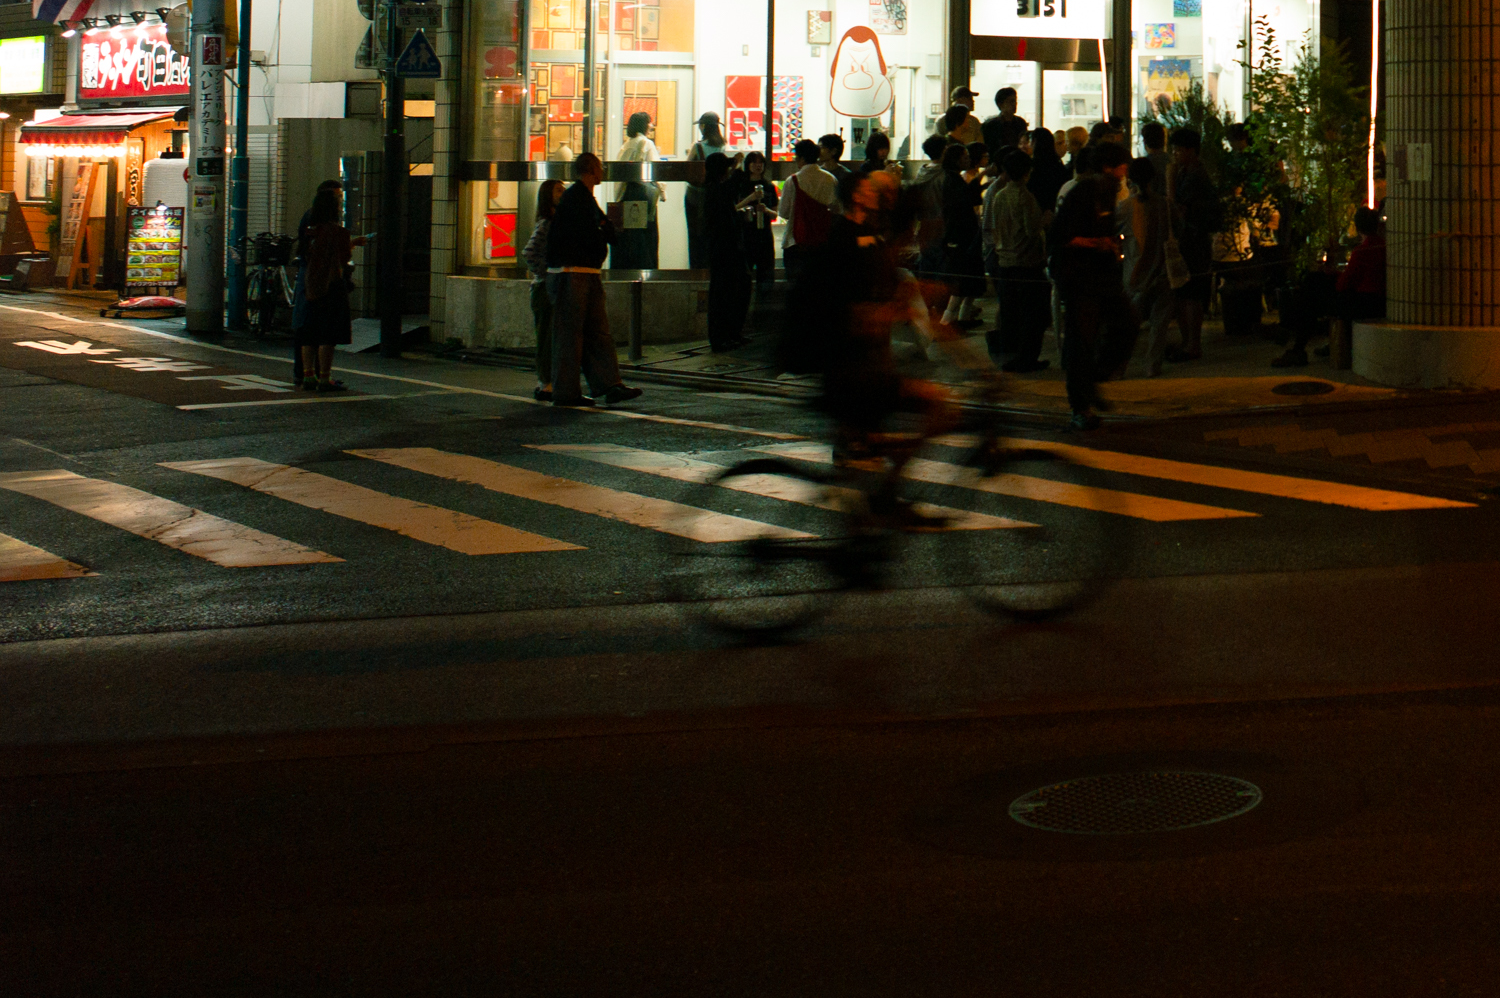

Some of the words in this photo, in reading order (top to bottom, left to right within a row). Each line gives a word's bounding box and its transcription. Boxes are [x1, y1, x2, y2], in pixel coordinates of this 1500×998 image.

[200, 69, 213, 144] バレエアカデミー
